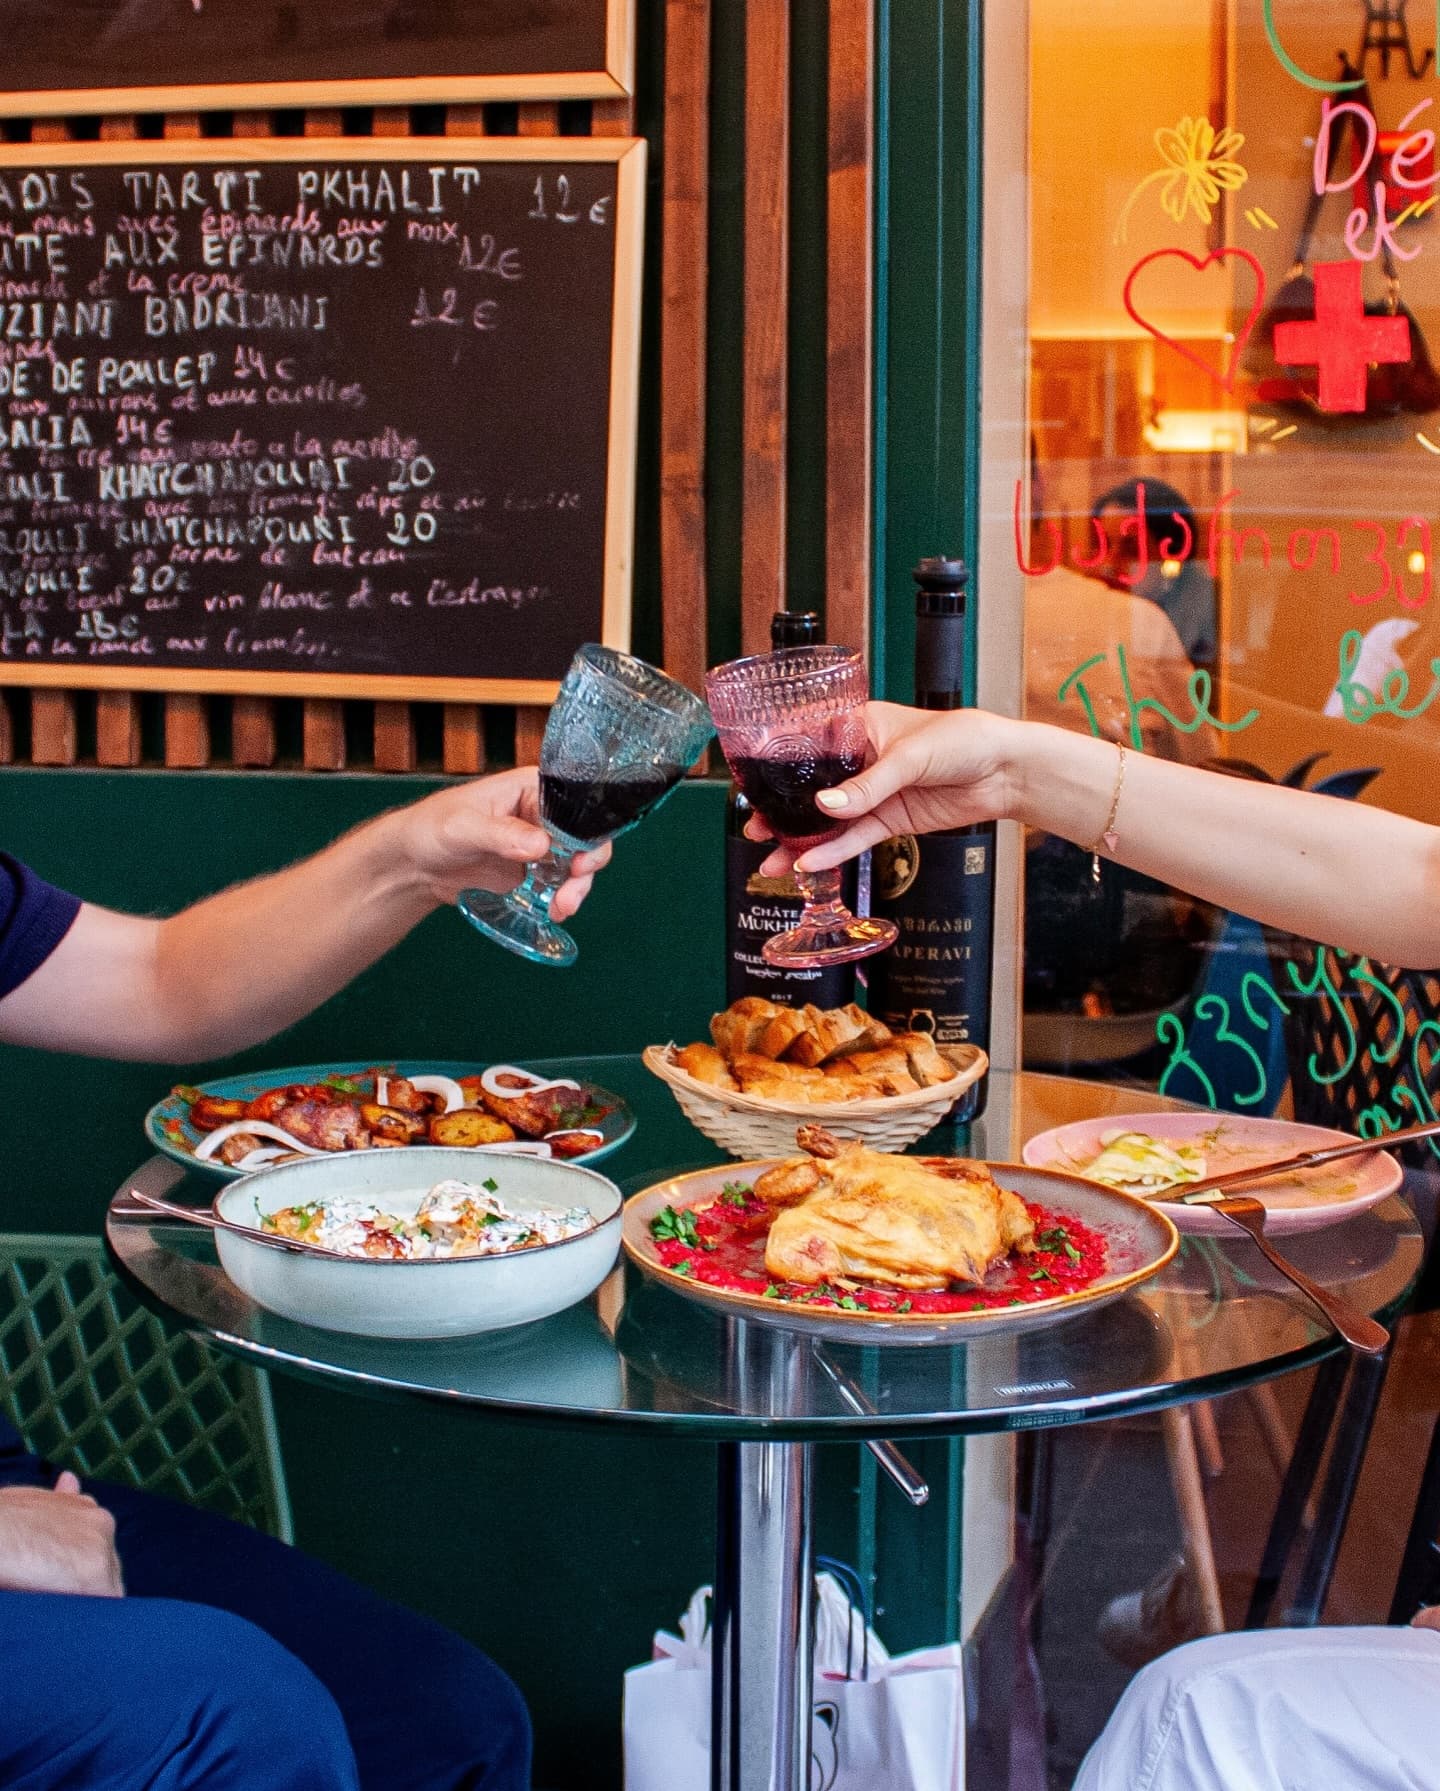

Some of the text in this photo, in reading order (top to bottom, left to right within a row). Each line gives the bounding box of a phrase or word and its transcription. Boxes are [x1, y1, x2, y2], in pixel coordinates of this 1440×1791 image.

[123, 170, 262, 211] TARTI
[298, 167, 481, 214] PKHALIT
[104, 231, 179, 268] AUX
[407, 219, 459, 243] noix
[52, 357, 86, 393] DE
[97, 351, 217, 395] POULET
[387, 455, 436, 494] 20
[387, 511, 437, 545] 20
[1058, 628, 1440, 752] The be
[738, 913, 803, 933] MUKHR
[750, 906, 800, 919] CHÂTE
